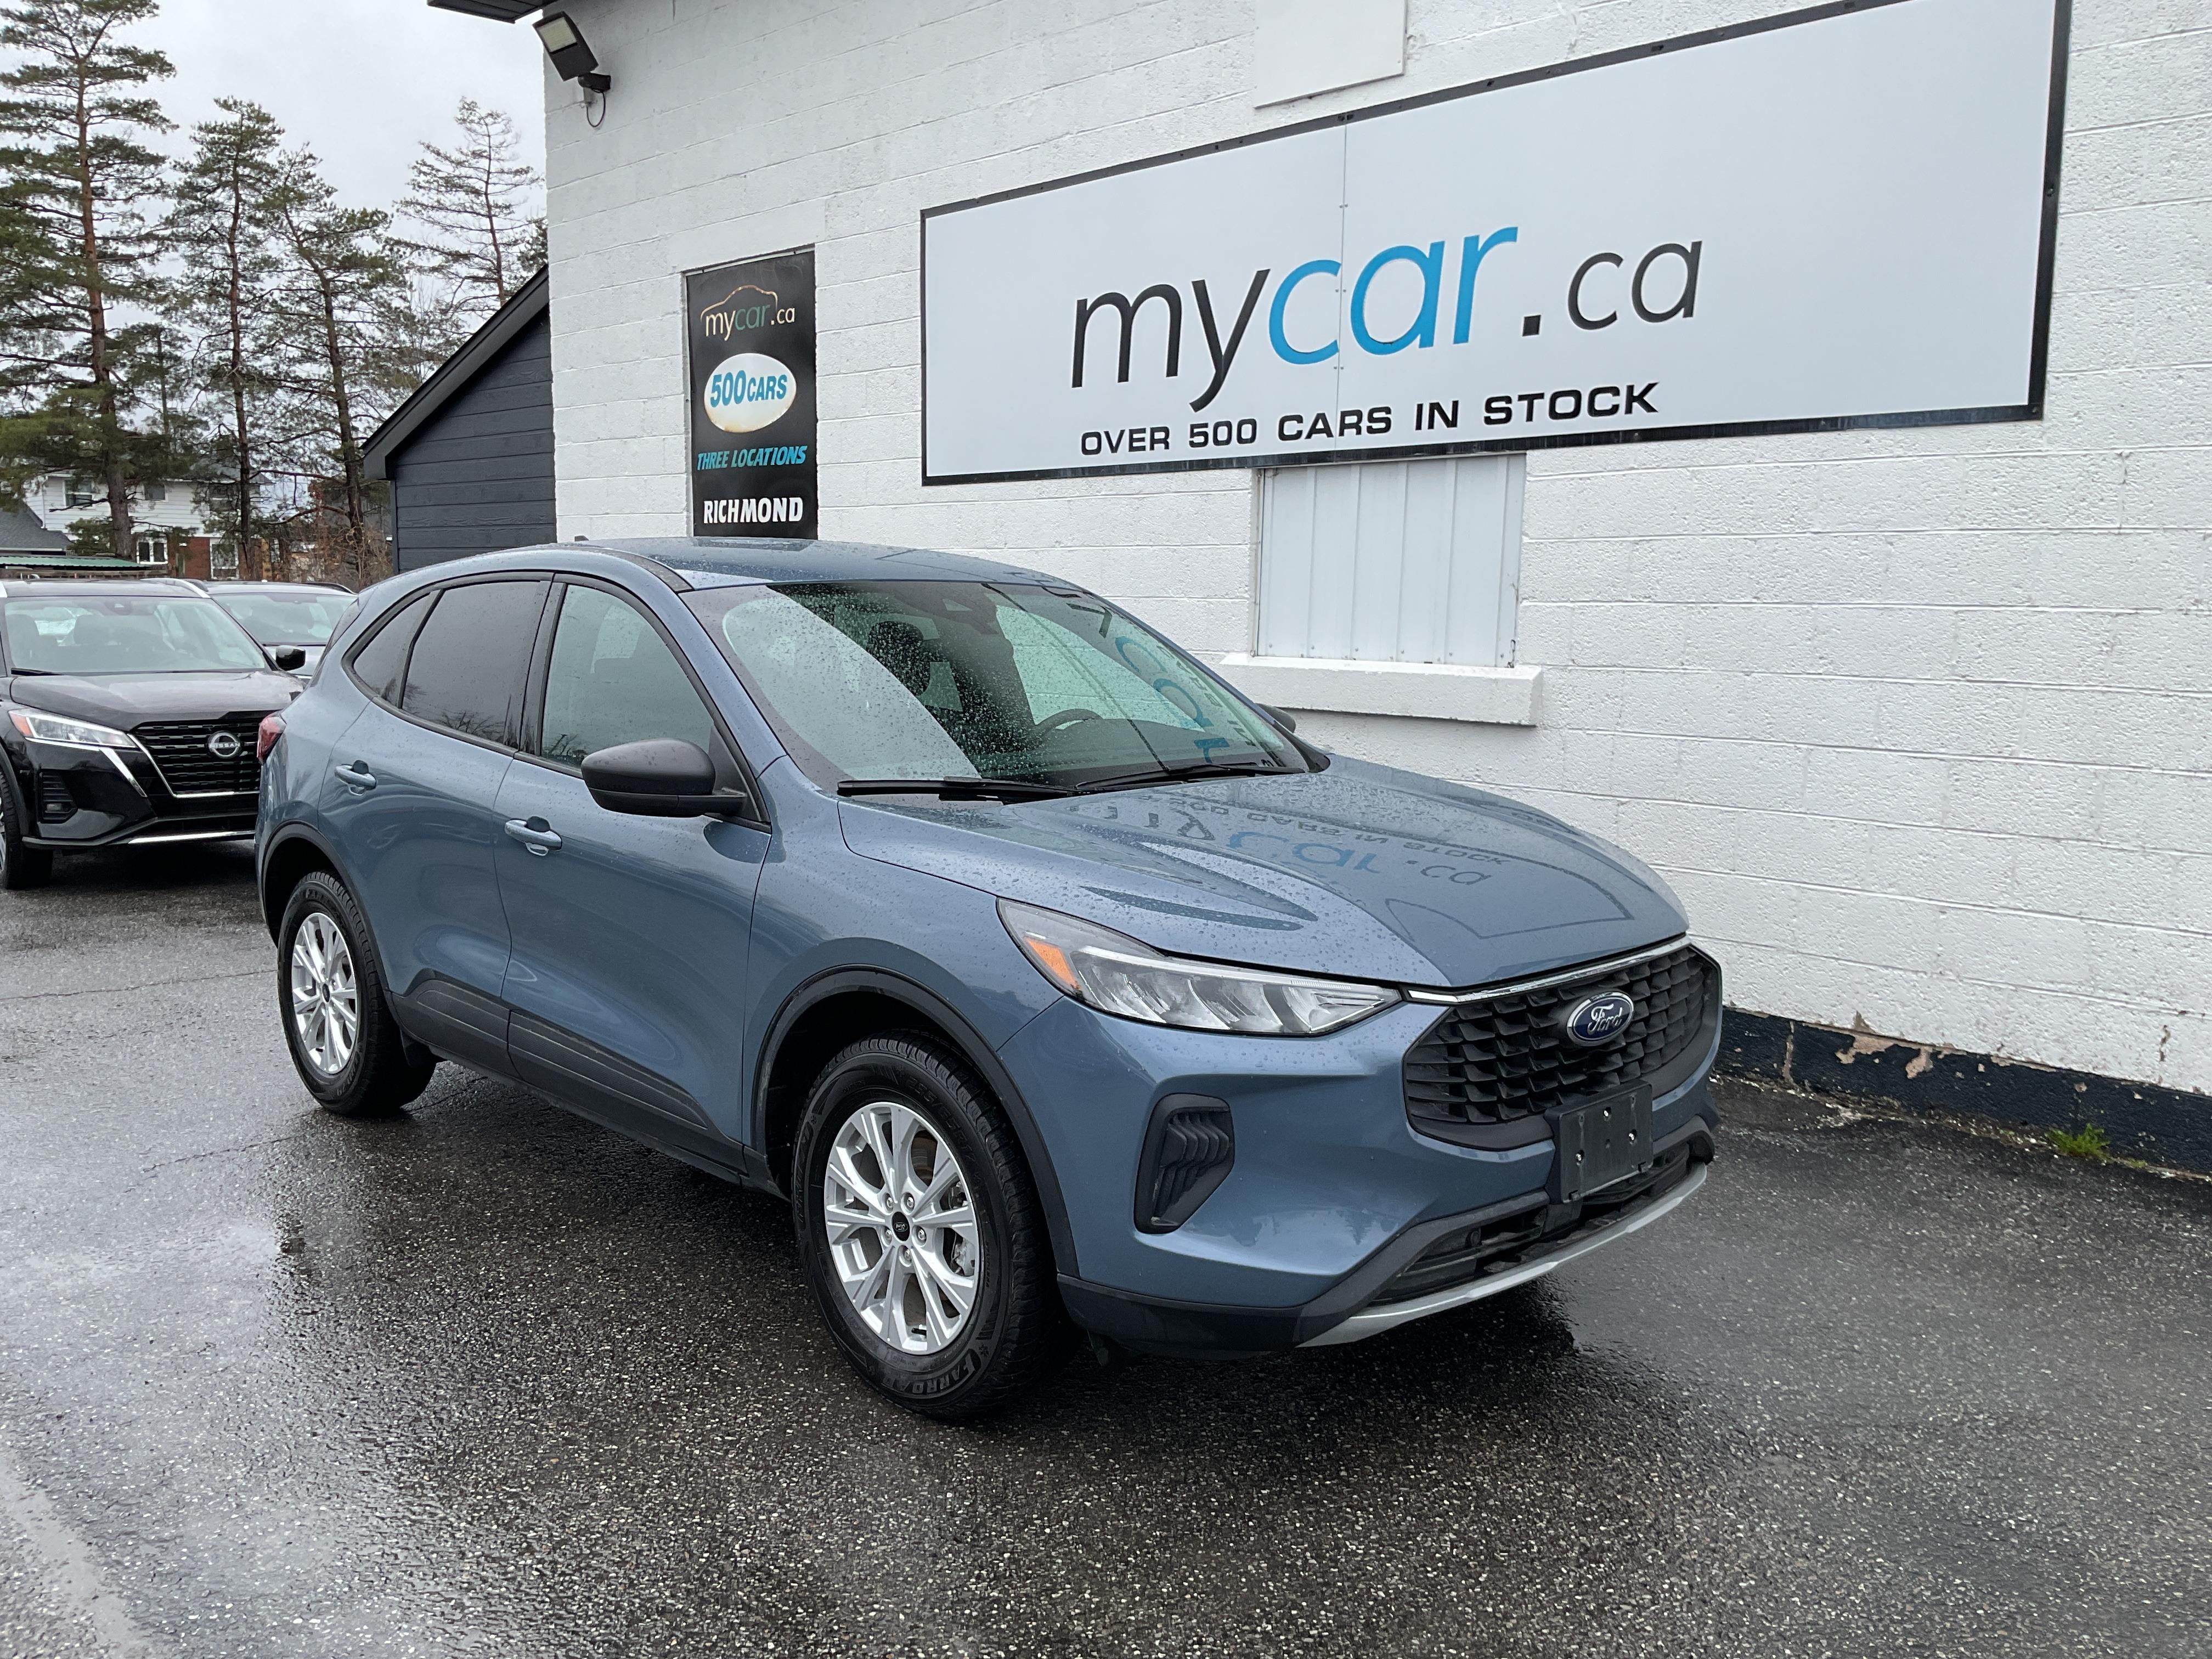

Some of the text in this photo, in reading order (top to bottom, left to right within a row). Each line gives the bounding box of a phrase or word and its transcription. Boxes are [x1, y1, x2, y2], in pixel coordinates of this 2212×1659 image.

[1081, 382, 1658, 455] OVER 500 CARS IN STOCK
[697, 445, 808, 471] THREE LOCATIONS
[703, 497, 803, 524] RICHMOND
[1587, 1003, 1623, 1035] Ford
